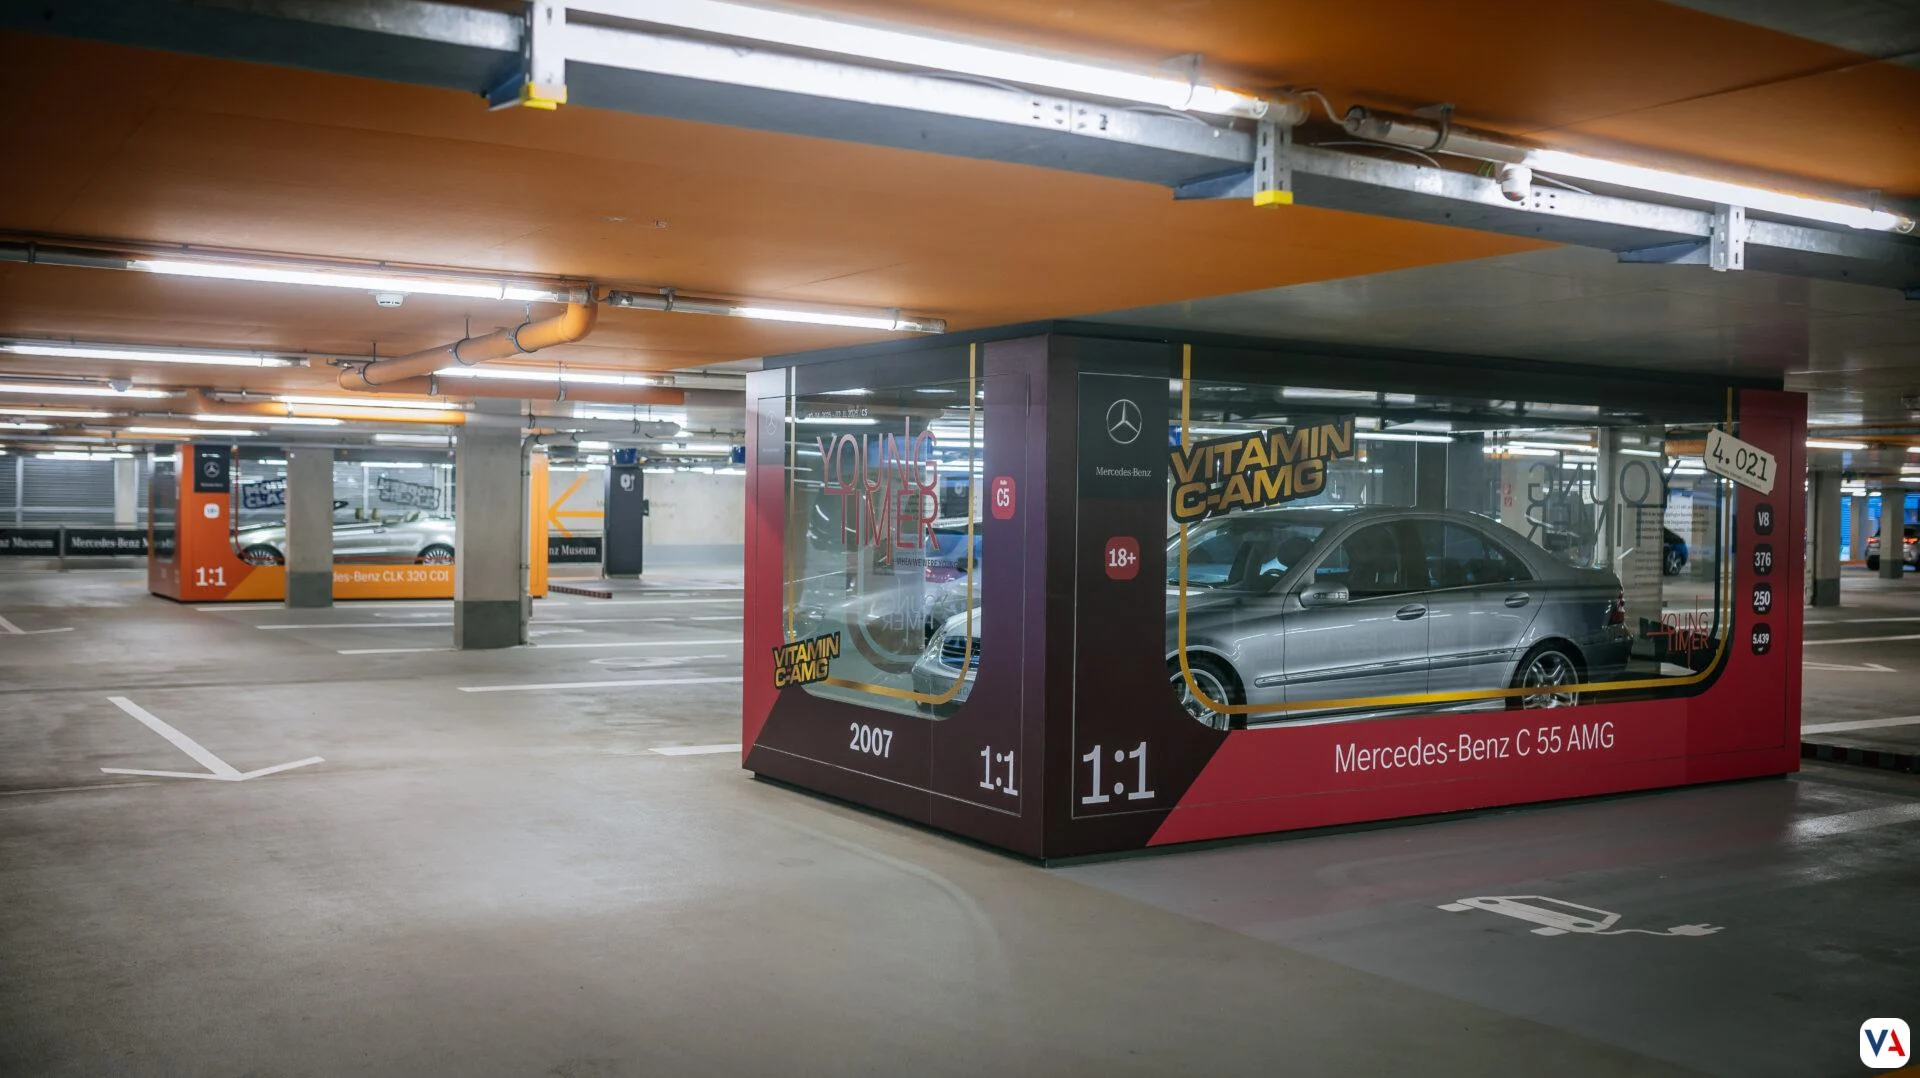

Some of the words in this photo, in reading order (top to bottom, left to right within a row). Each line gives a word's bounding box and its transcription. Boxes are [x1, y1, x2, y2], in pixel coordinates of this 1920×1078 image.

[817, 416, 938, 491] YOUNG
[1170, 420, 1352, 484] VITAMIN
[1096, 466, 1151, 477] Mercedes-Benz
[997, 488, 1009, 506] C5
[1175, 459, 1324, 518] C-AMG
[824, 488, 940, 565] TIMER
[1758, 512, 1769, 526] V8
[13, 537, 53, 548] Museum
[72, 537, 140, 548] Mercedes-Benz
[562, 545, 596, 555] Museum
[1109, 548, 1136, 568] 18+
[1754, 552, 1771, 566] 376
[195, 566, 226, 586] 1:1
[383, 571, 404, 582] CLK
[407, 571, 427, 582] 320
[429, 571, 449, 582] CDI
[1754, 591, 1770, 605] 250
[1753, 634, 1770, 644] 5.439
[774, 634, 839, 668] VITAMIN
[775, 658, 828, 687] C-AMG
[849, 723, 893, 758] 2007
[1335, 734, 1510, 773] Mercedes-Benz
[1516, 729, 1531, 756] C
[1536, 726, 1562, 755] 55
[1567, 721, 1615, 750] AMG
[979, 745, 1018, 797] 1:1
[1081, 741, 1155, 804] 1:1
